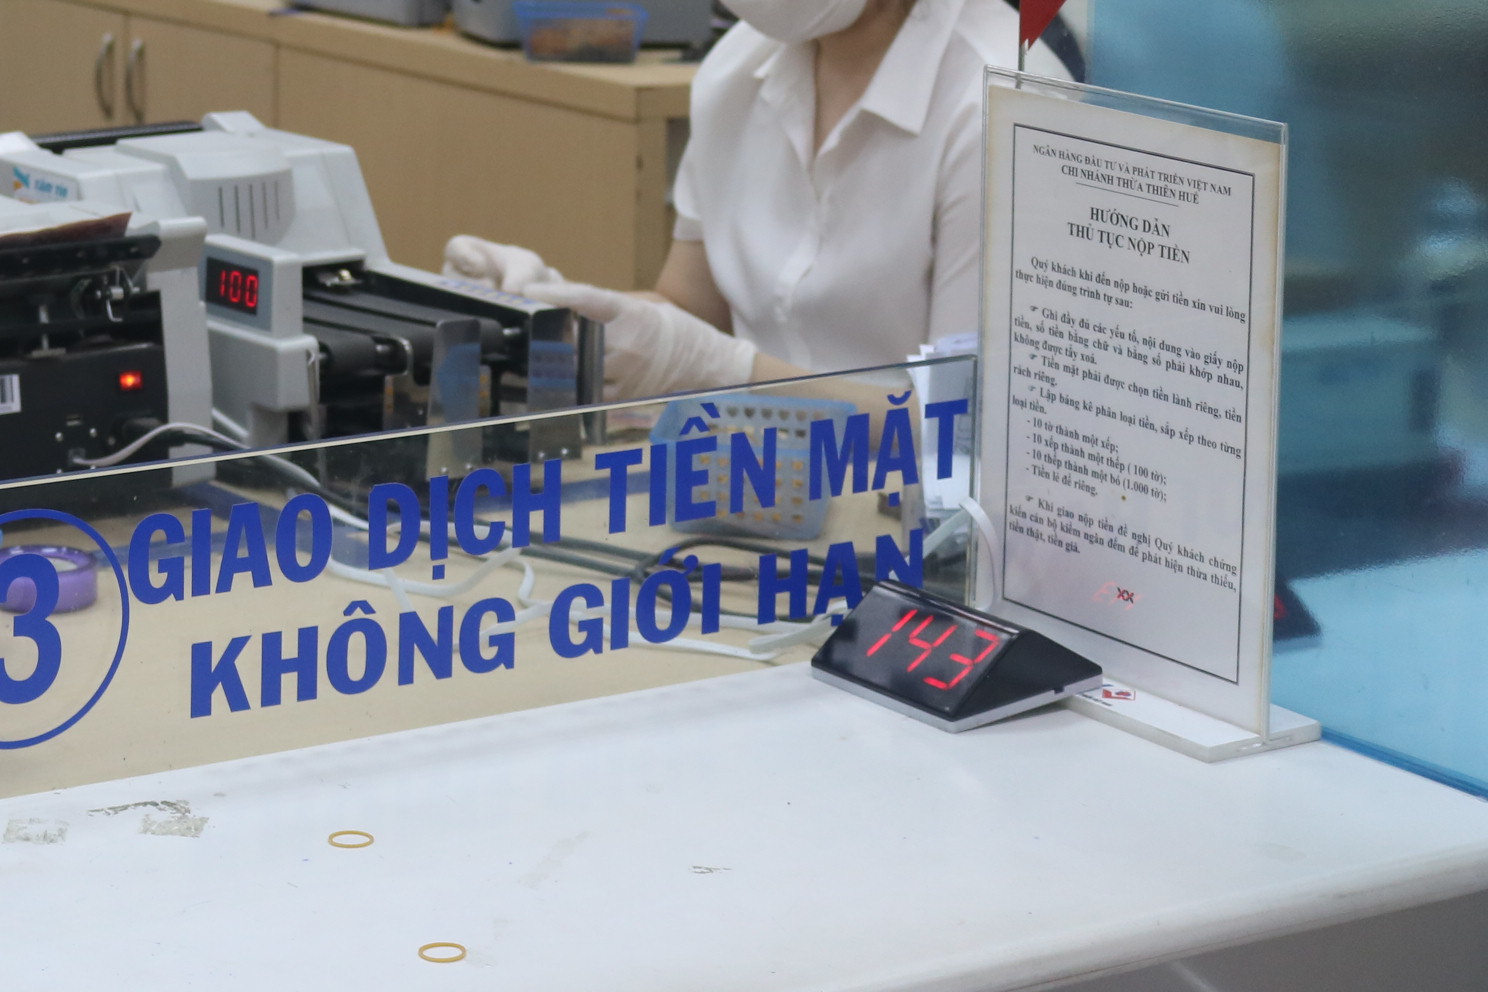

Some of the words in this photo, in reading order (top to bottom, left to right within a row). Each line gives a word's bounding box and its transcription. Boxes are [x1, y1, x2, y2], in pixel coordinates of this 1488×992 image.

[219, 268, 259, 308] 100
[1078, 268, 1093, 282] khi
[1191, 298, 1206, 311] xin
[1208, 304, 1223, 316] vui
[1040, 307, 1058, 321] Ghi
[1157, 339, 1182, 358] dung
[1032, 416, 1043, 429] 10
[1197, 434, 1217, 449] theo
[1032, 432, 1042, 444] 10
[1133, 464, 1149, 478] 100
[1032, 448, 1042, 461] 10
[1122, 477, 1149, 495] (1.000
[128, 494, 333, 605] GIAO
[368, 458, 562, 580] DỊCH
[595, 402, 778, 534] TIỀN
[811, 390, 969, 507] MẶT
[1037, 497, 1054, 513] Khi
[1056, 505, 1075, 522] giao
[190, 597, 516, 719] KHÔNG
[548, 546, 721, 660] GIỚI
[758, 528, 924, 627] HẠN
[866, 608, 1001, 691] 143
